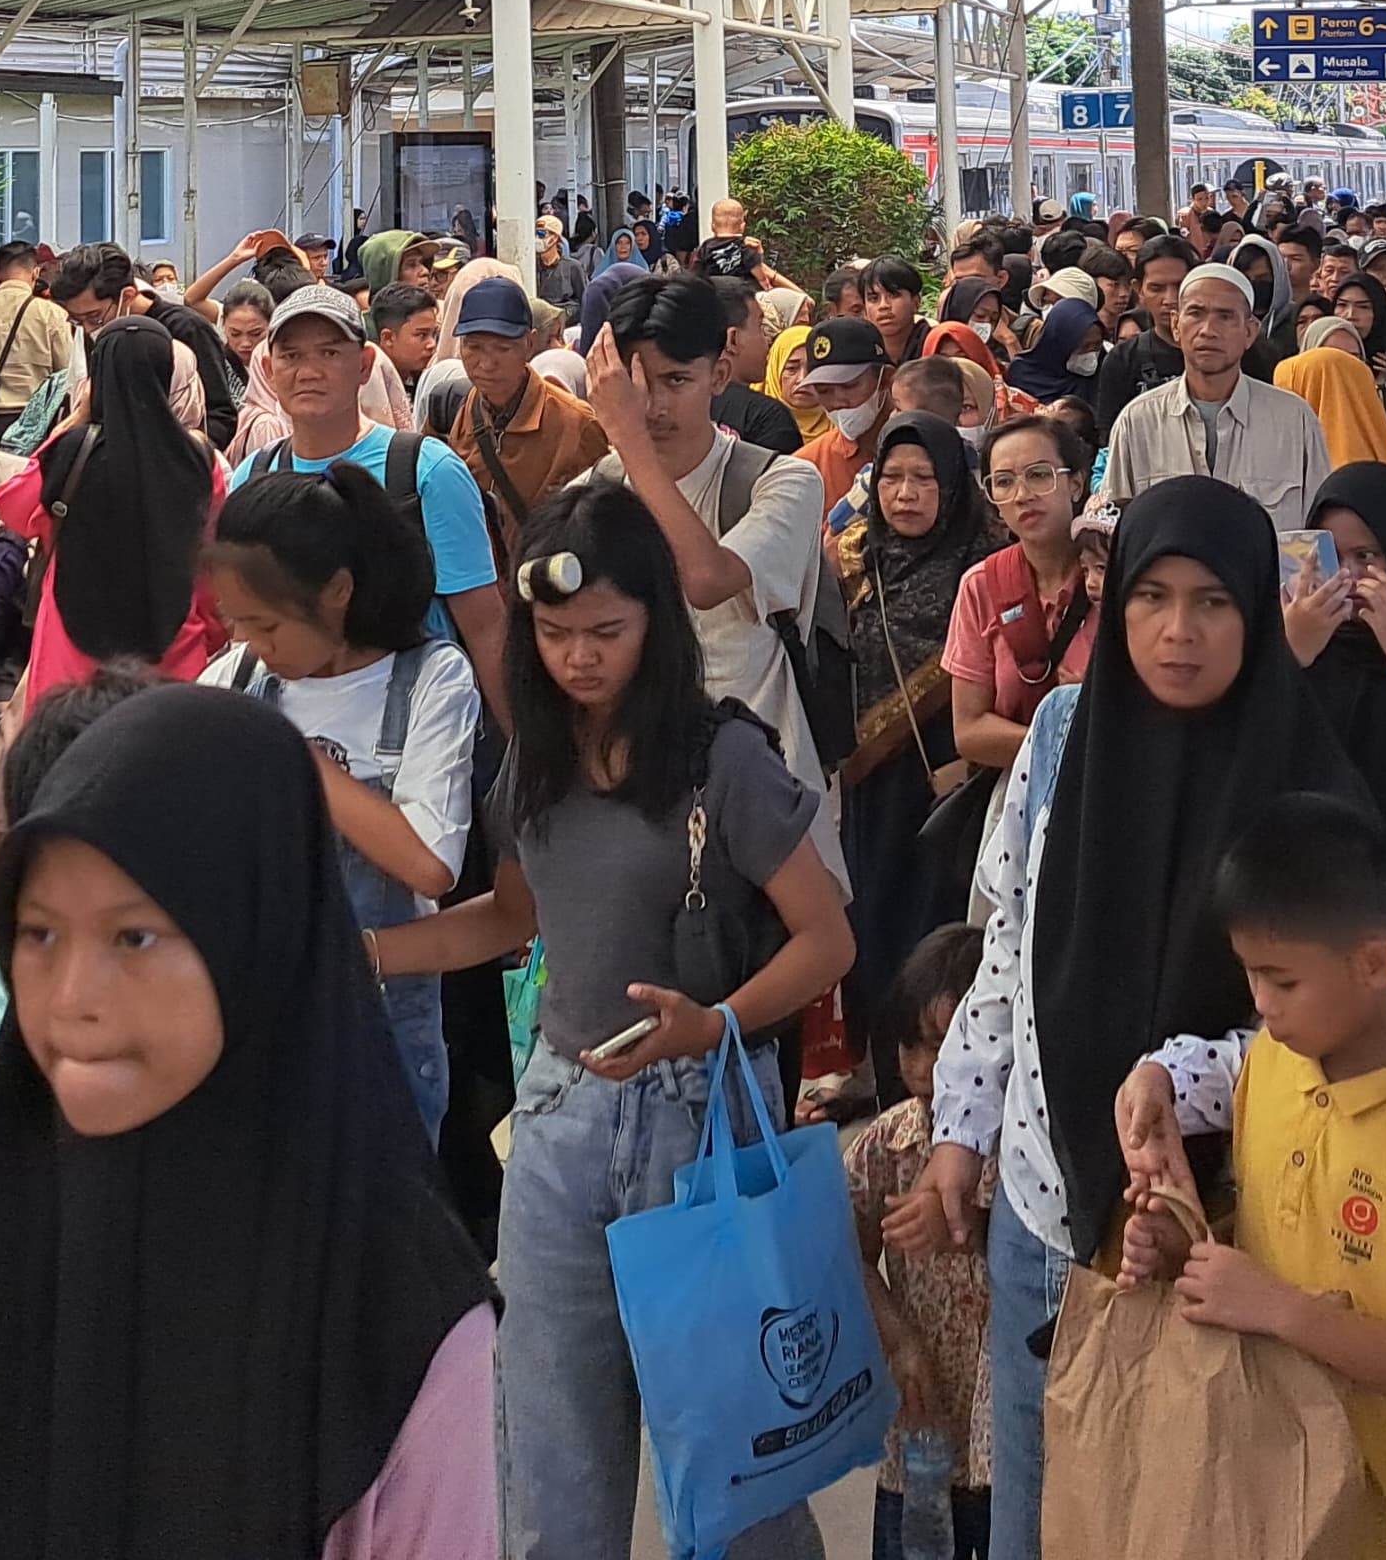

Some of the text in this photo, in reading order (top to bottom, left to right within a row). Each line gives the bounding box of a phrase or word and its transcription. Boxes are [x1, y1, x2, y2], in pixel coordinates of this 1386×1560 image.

[1320, 17, 1356, 28] Peron
[1320, 30, 1355, 38] Platform
[1322, 56, 1368, 67] Musala
[1322, 68, 1379, 78] Praying Room
[1073, 105, 1089, 126] 8
[1114, 104, 1131, 124] 7
